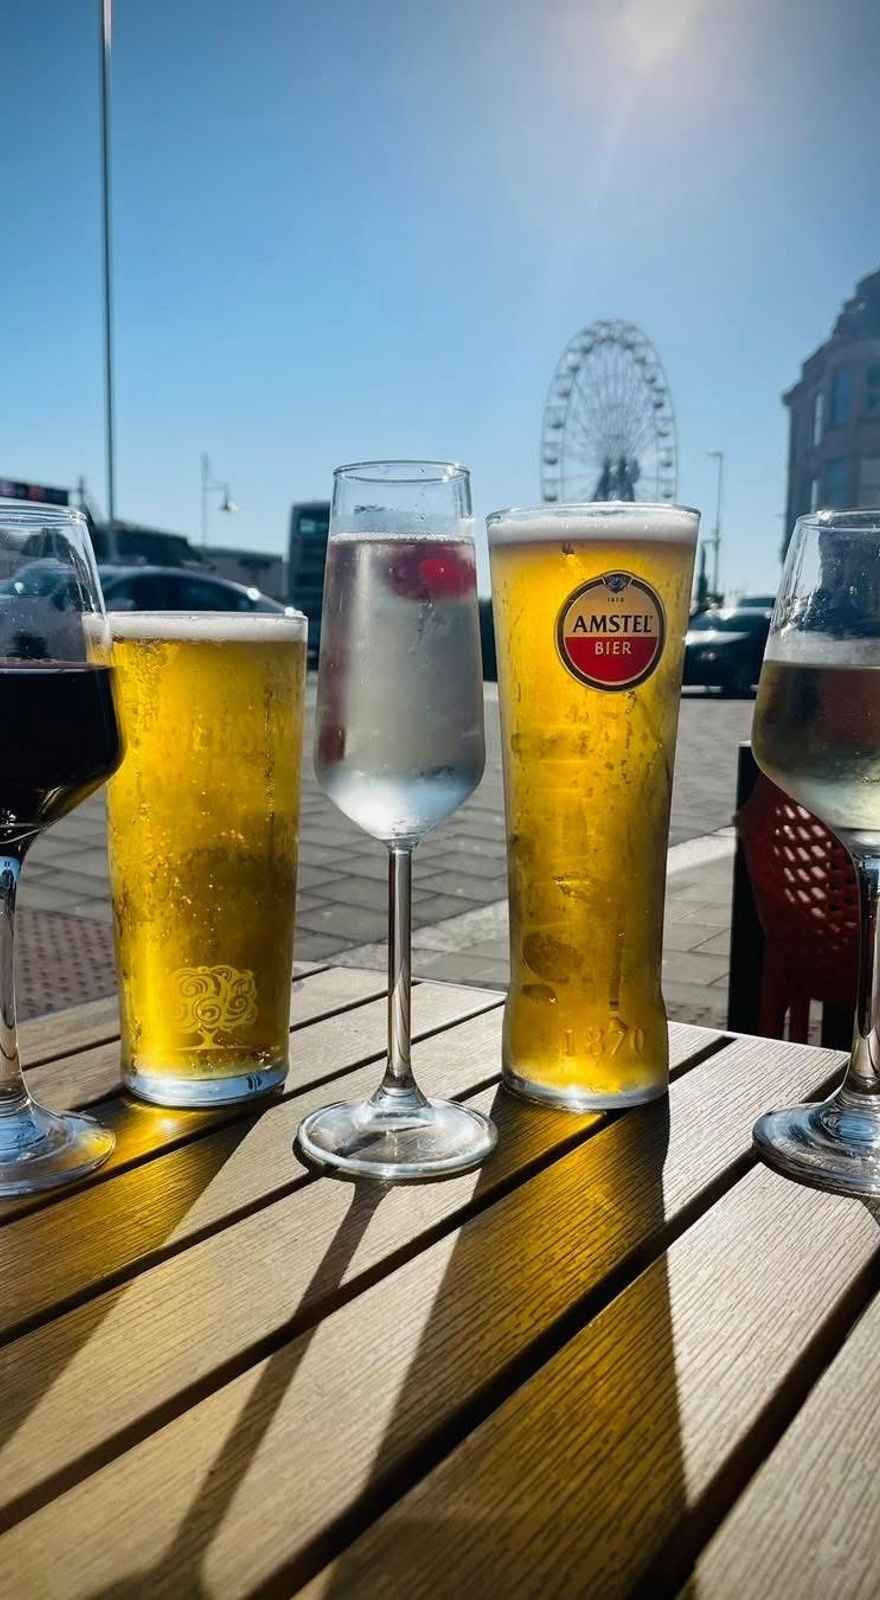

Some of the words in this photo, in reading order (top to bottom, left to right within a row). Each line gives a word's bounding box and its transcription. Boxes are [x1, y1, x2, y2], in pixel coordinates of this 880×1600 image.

[572, 614, 652, 633] AMSTEL
[594, 641, 632, 655] BIER
[564, 1027, 646, 1058] 1870
